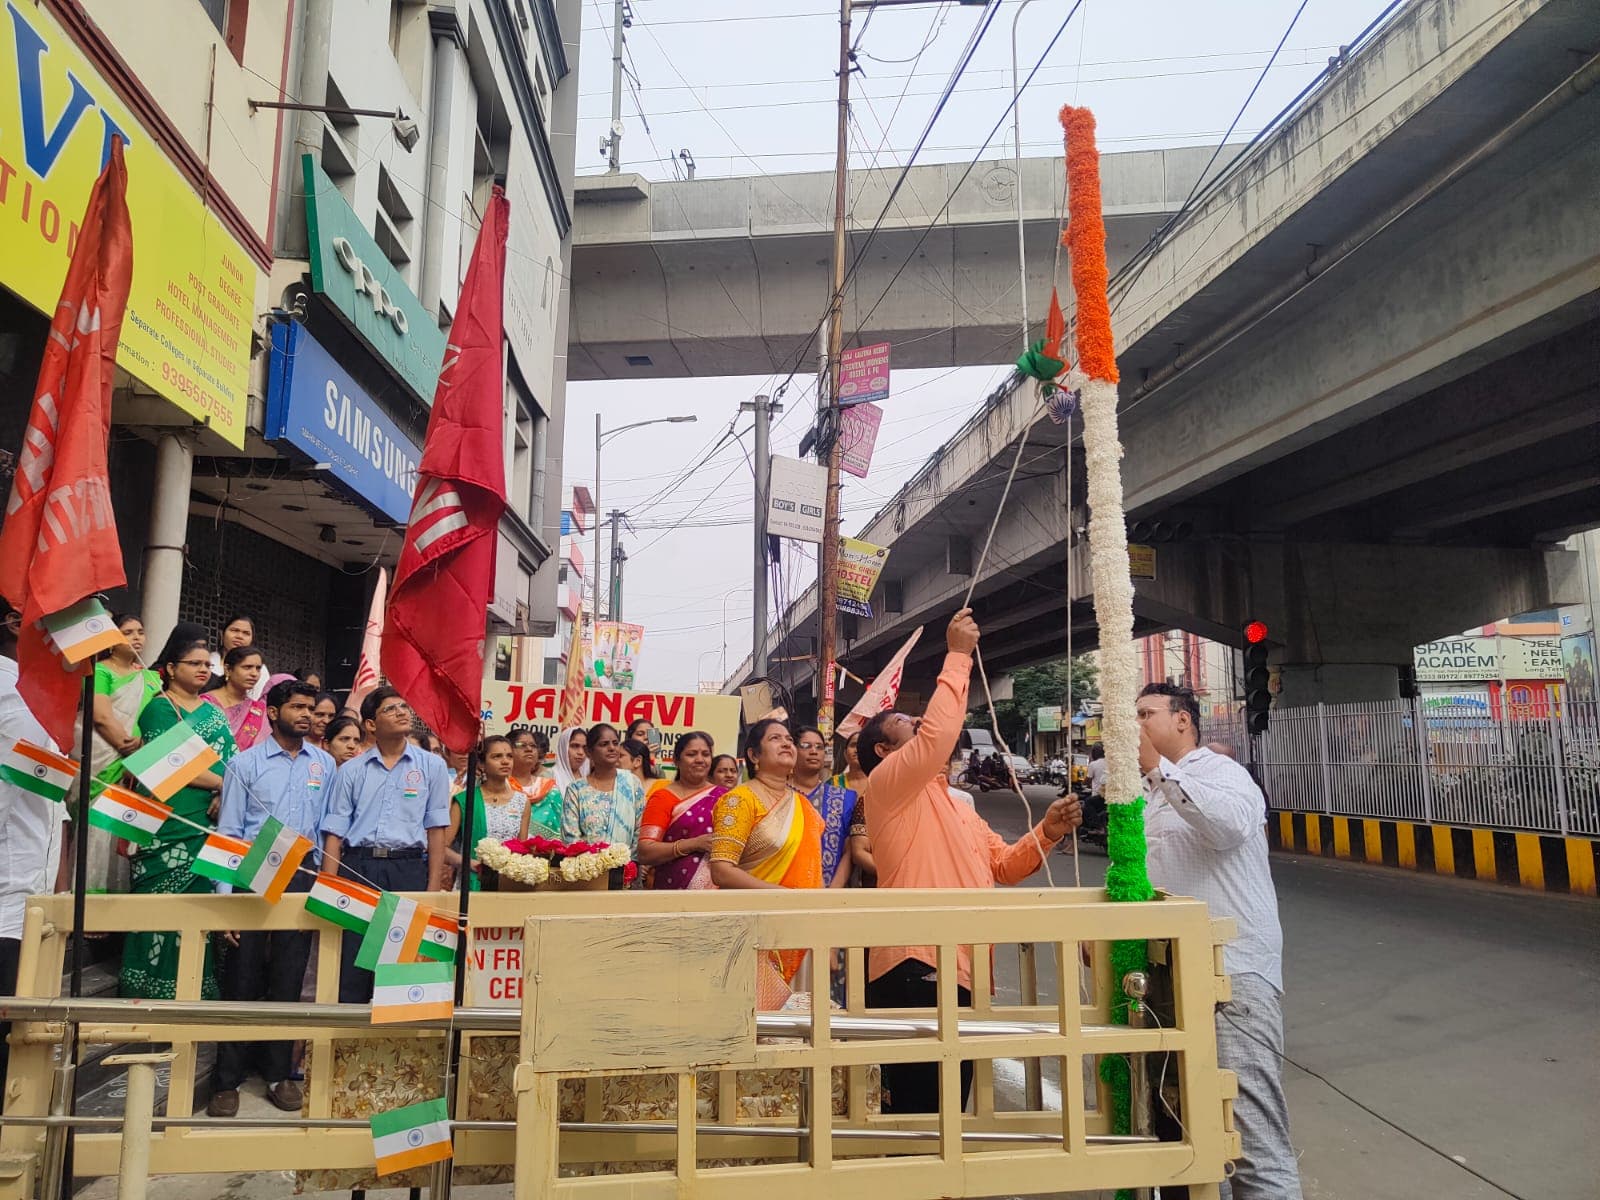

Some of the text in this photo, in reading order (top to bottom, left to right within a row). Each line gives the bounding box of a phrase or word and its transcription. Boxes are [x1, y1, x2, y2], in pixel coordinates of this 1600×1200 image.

[219, 276, 242, 308] DEGREE
[222, 254, 244, 286] JUNIOR
[167, 280, 238, 353] HOTEL MANAGEMENT
[188, 272, 240, 331] POST GRADUATE
[130, 309, 160, 341] Separate
[156, 297, 236, 376] PROFESSIONAL STUDIES
[161, 361, 234, 427] 9395567555
[1416, 641, 1477, 655] SPARK
